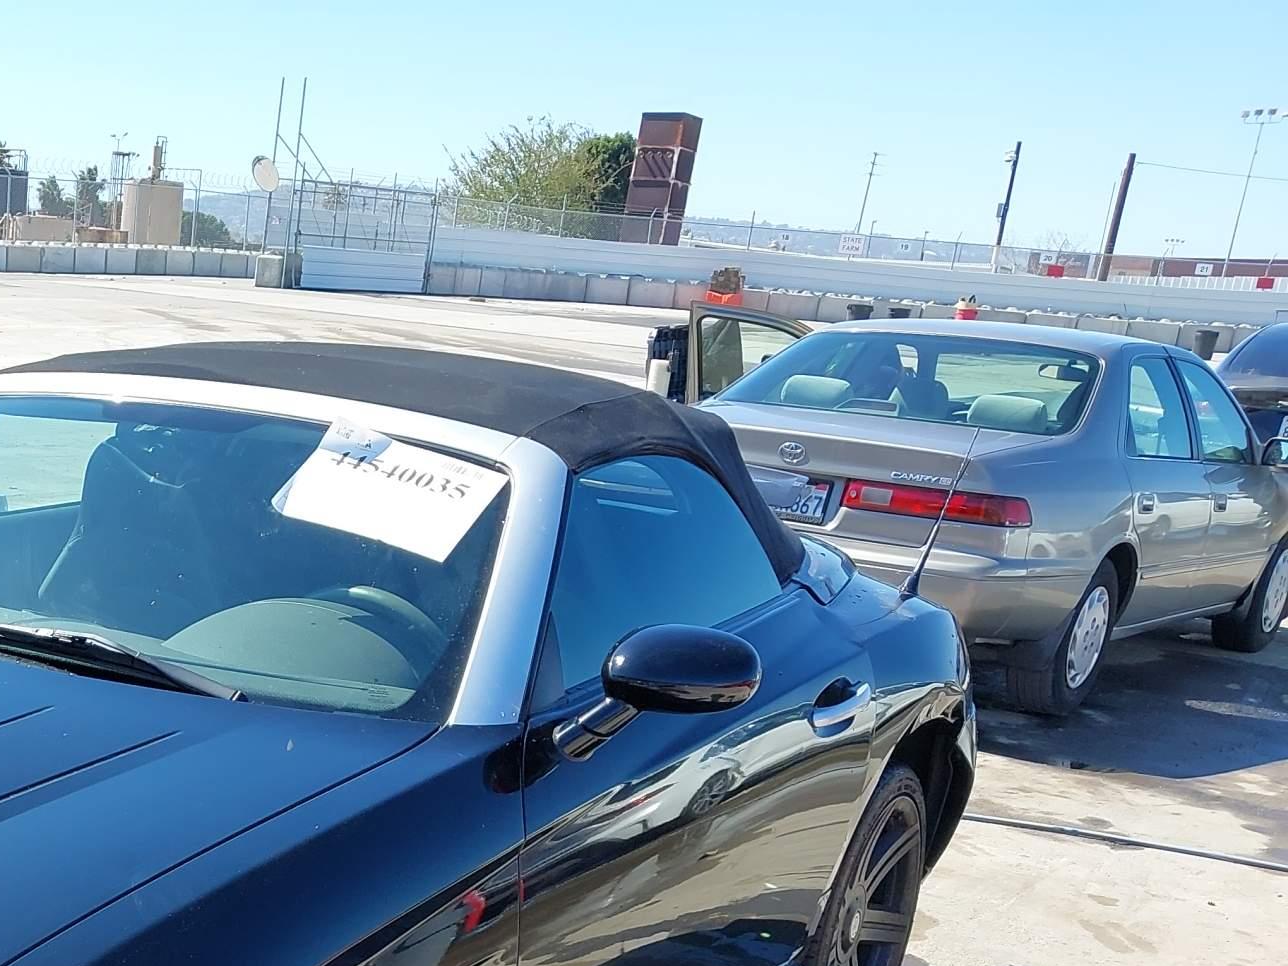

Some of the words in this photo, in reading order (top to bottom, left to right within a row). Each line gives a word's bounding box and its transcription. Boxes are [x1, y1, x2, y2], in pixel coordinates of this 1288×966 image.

[841, 236, 863, 244] STATE
[1042, 254, 1053, 262] 20
[1199, 265, 1209, 273] 21
[330, 450, 471, 499] 44540035
[889, 471, 940, 483] CAMRY
